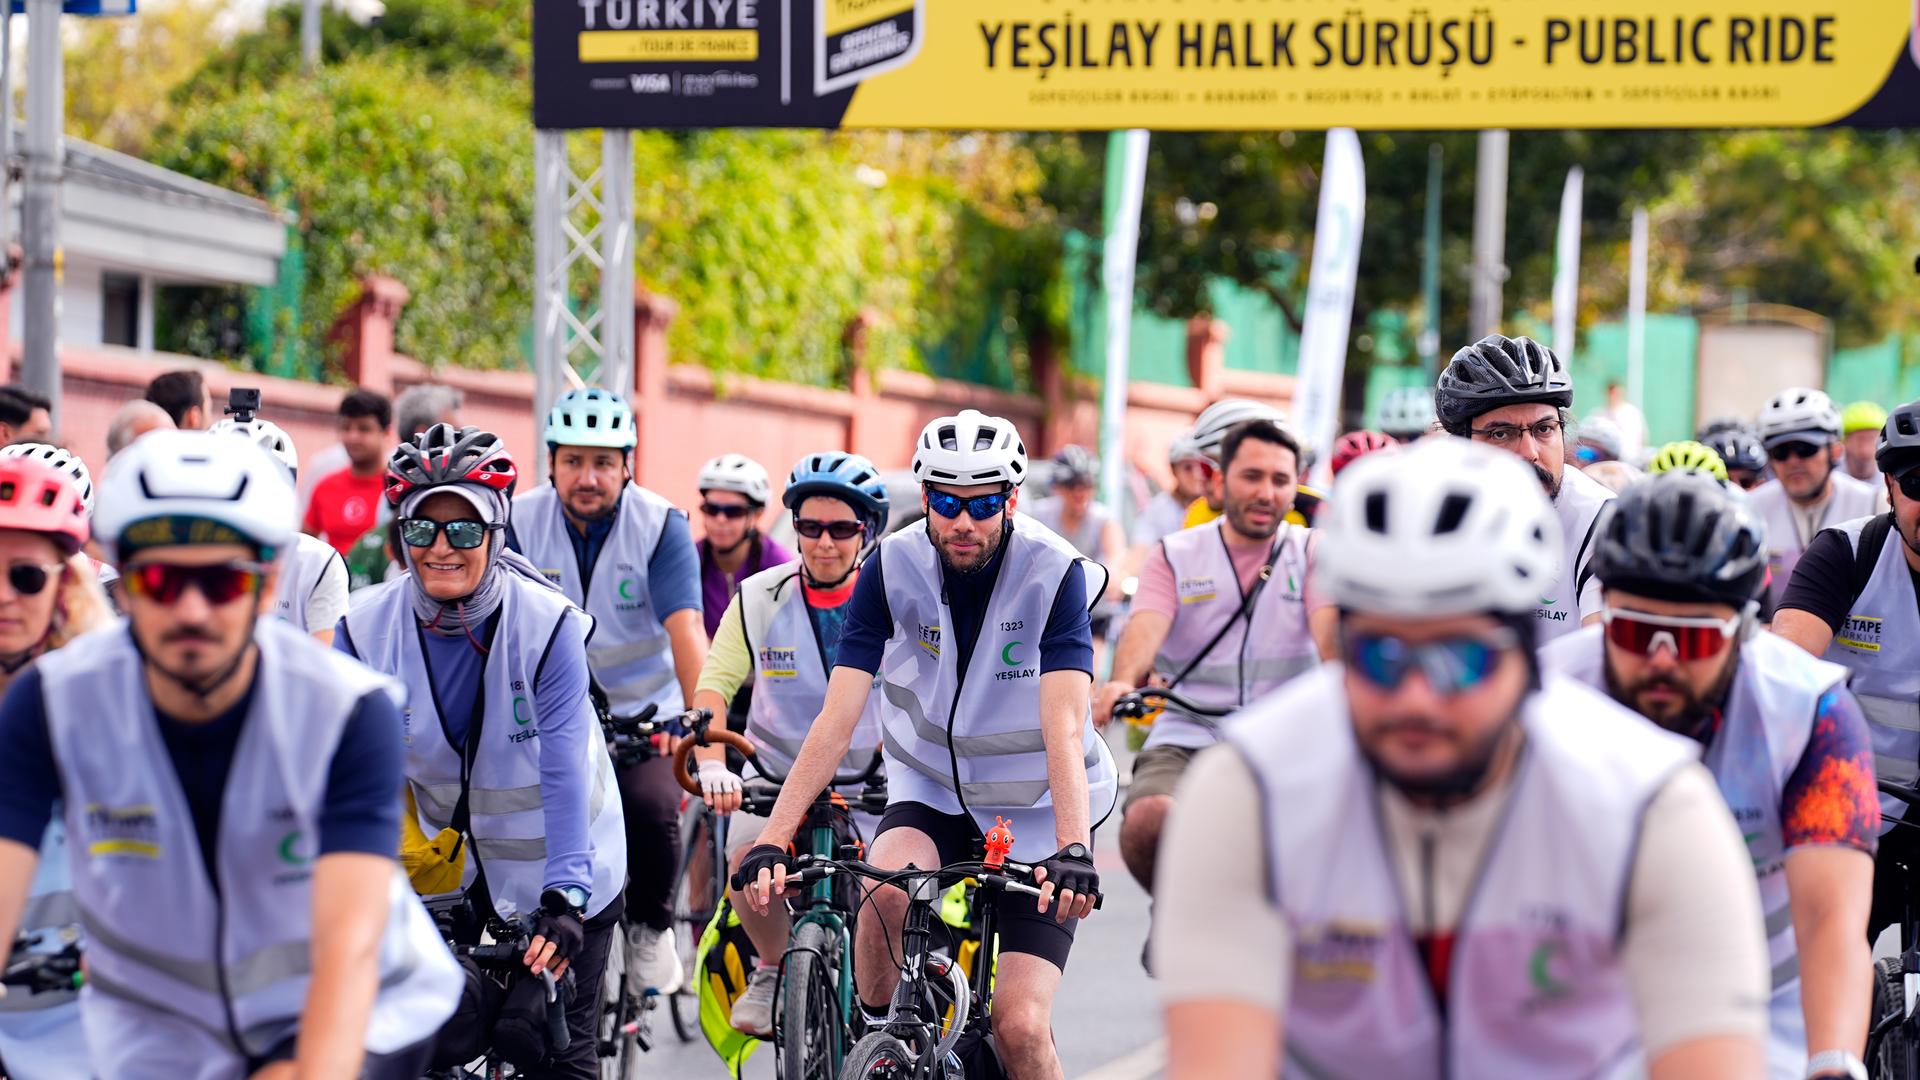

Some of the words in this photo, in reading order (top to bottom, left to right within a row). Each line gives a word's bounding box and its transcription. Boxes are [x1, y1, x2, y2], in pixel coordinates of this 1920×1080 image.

[978, 12, 1161, 80] YEŞİLAY
[1177, 20, 1297, 69] HALK
[1311, 9, 1496, 79] SÜRÜŞÜ
[1543, 16, 1714, 67] PUBLIC
[1727, 14, 1837, 65] RIDE
[1000, 620, 1024, 631] 1323
[1843, 614, 1882, 634] ÉTAPE
[994, 668, 1036, 681] YEŞİLAY
